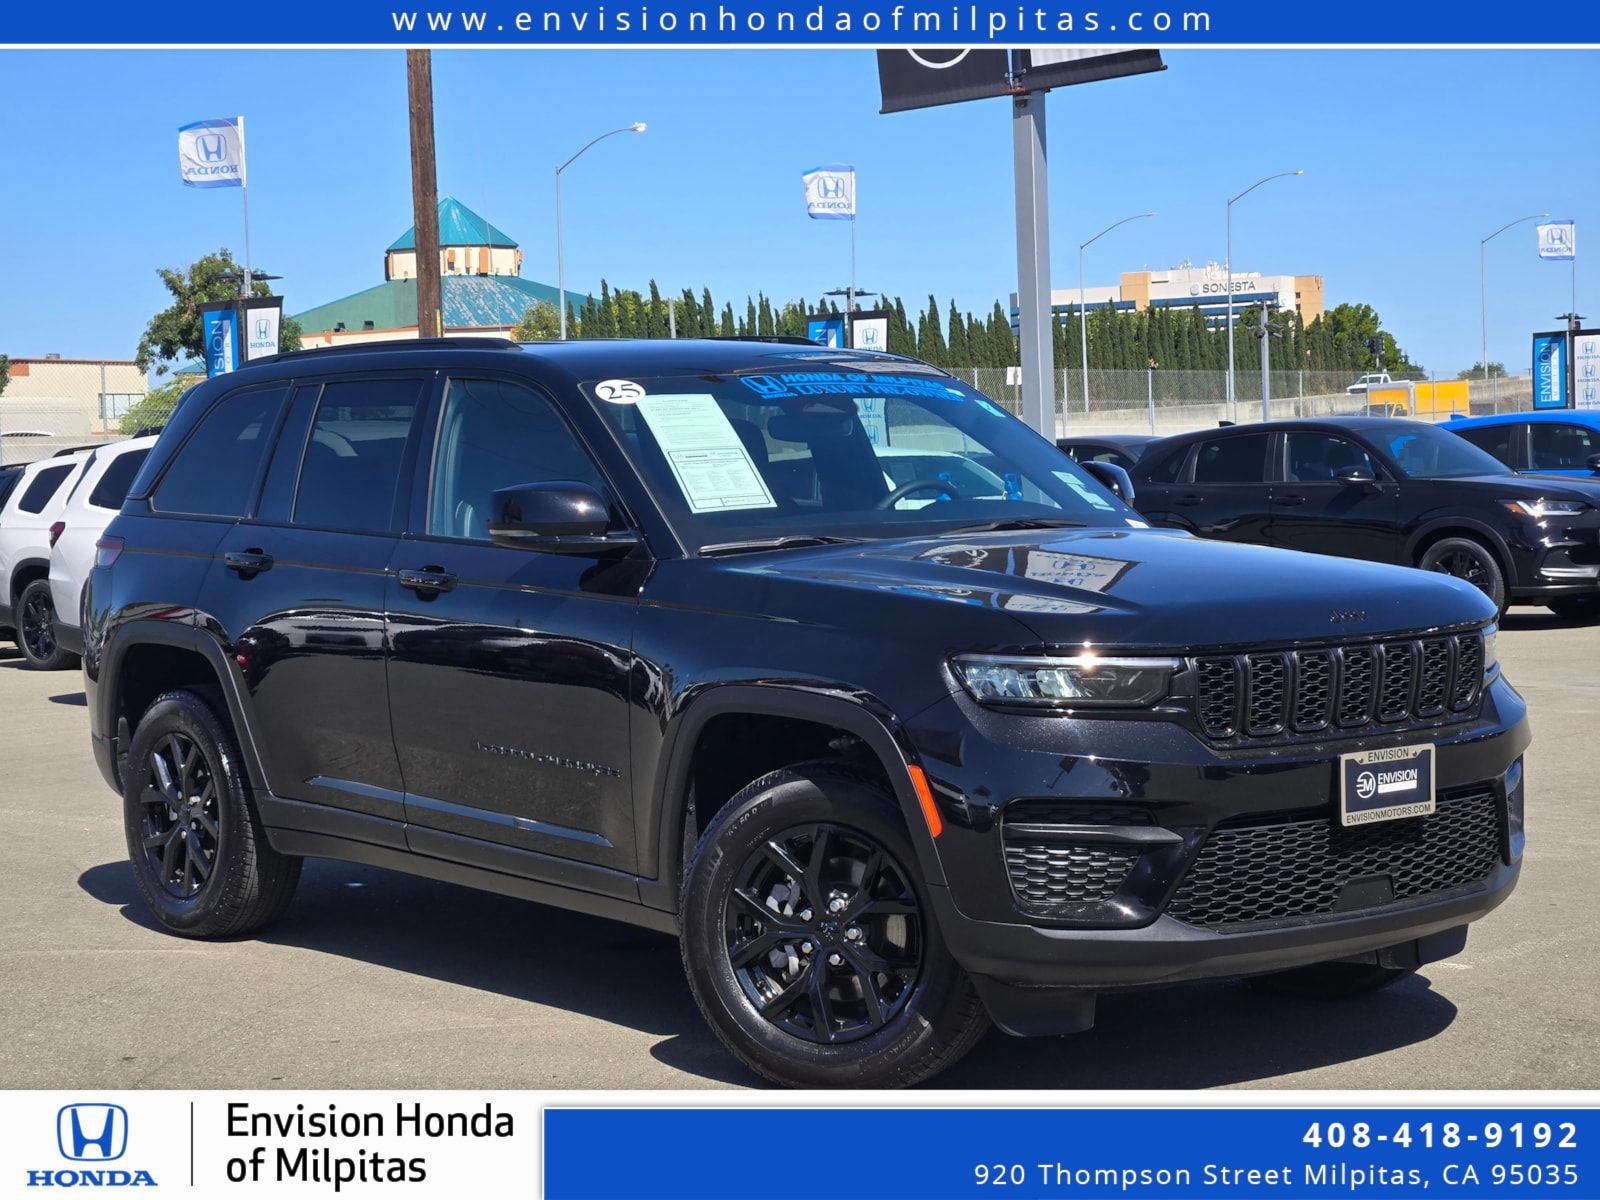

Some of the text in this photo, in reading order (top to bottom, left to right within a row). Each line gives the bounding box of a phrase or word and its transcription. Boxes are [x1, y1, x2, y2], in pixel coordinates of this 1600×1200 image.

[1202, 281, 1256, 293] SONESTA
[780, 373, 846, 383] HONDA
[846, 373, 868, 383] OF
[1540, 343, 1552, 402] ENVISION
[600, 383, 641, 400] 25
[1367, 748, 1409, 762] ENVISION
[1378, 768, 1418, 785] ENVISION
[1346, 803, 1431, 824] ENVISIONMOTORS.COM
